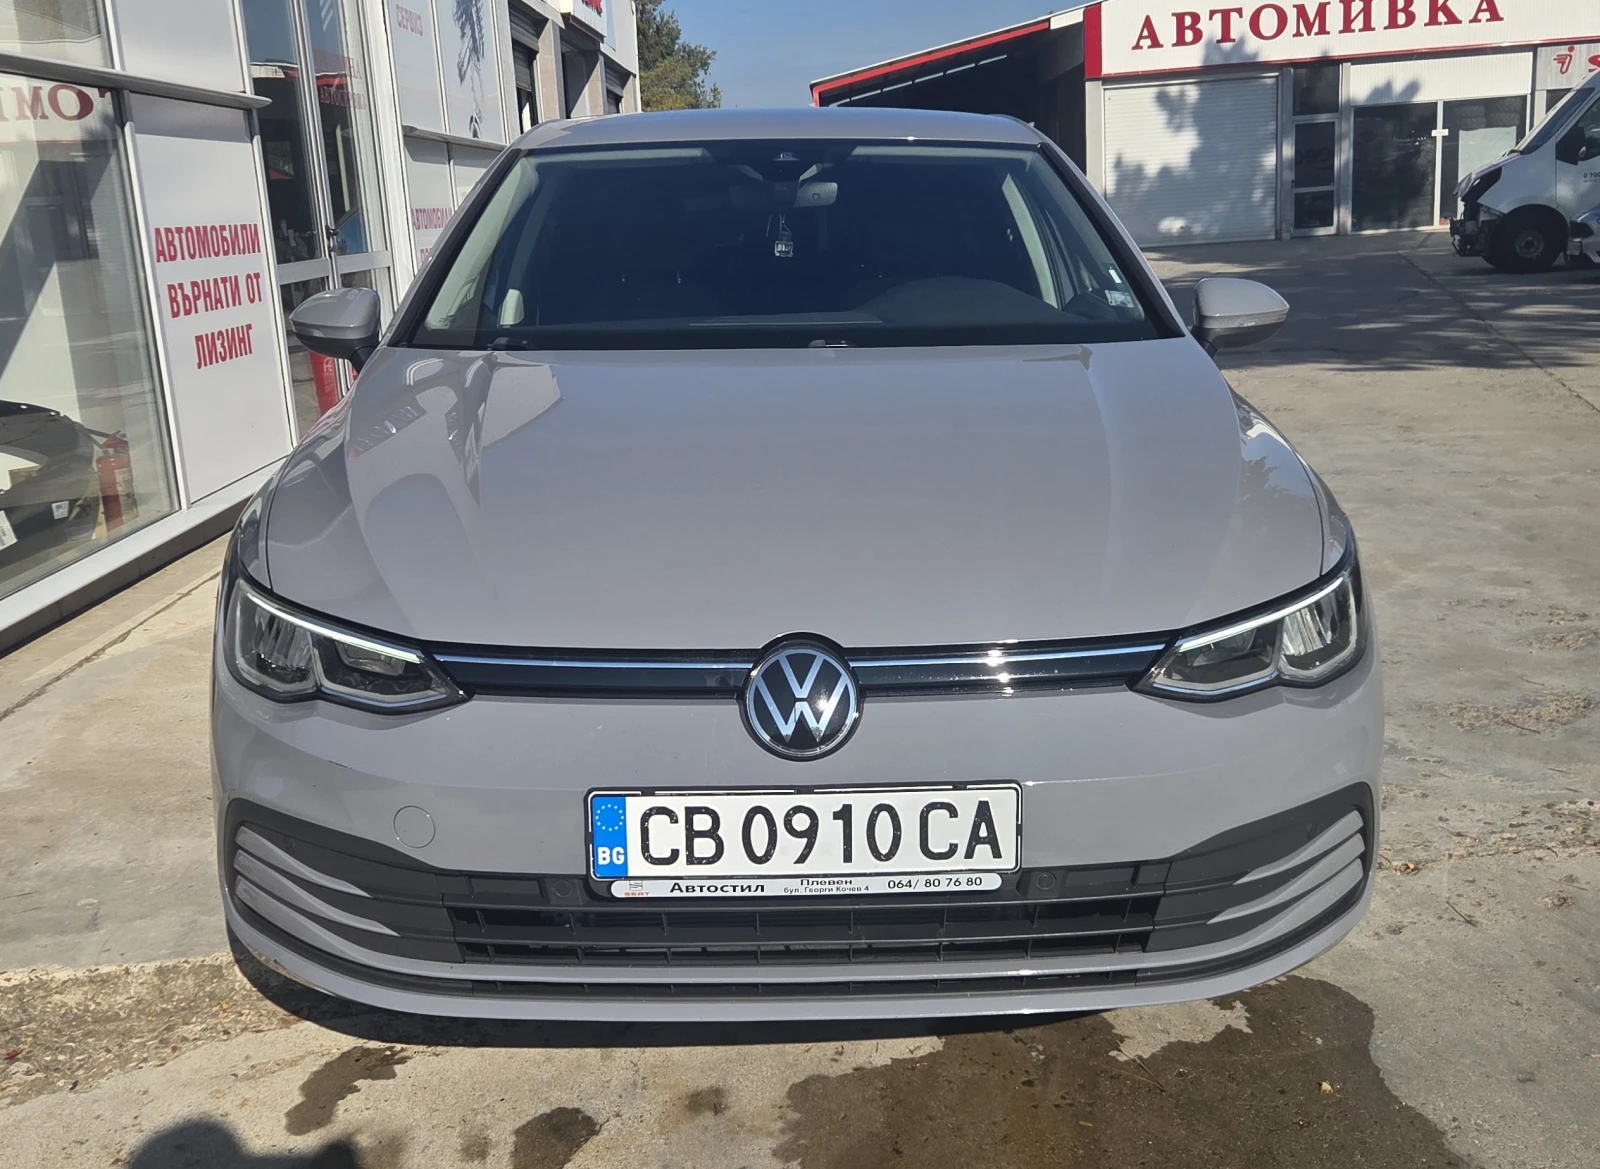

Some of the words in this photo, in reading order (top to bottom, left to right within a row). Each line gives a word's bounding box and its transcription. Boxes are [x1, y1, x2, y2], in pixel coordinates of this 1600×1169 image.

[396, 4, 424, 37] СЕРВИЗ
[1131, 0, 1504, 50] АВТОМИВКА
[154, 223, 261, 263] АВТОМОБИЛИ
[166, 274, 242, 319] ВЪРНАТИ
[245, 271, 263, 304] ОТ
[194, 323, 253, 370] ЛИЗИНГ
[640, 805, 725, 866] CB
[741, 803, 902, 865] 0910
[918, 799, 1003, 861] CA
[597, 846, 626, 866] BG
[669, 882, 766, 893] Автостил
[783, 886, 802, 894] бул.
[804, 886, 834, 894] Георги
[836, 885, 862, 893] Кочев
[800, 878, 853, 886] Плевен
[887, 878, 920, 890] 064/
[924, 878, 941, 888] 80
[945, 877, 962, 887] 76
[966, 876, 983, 887] 80
